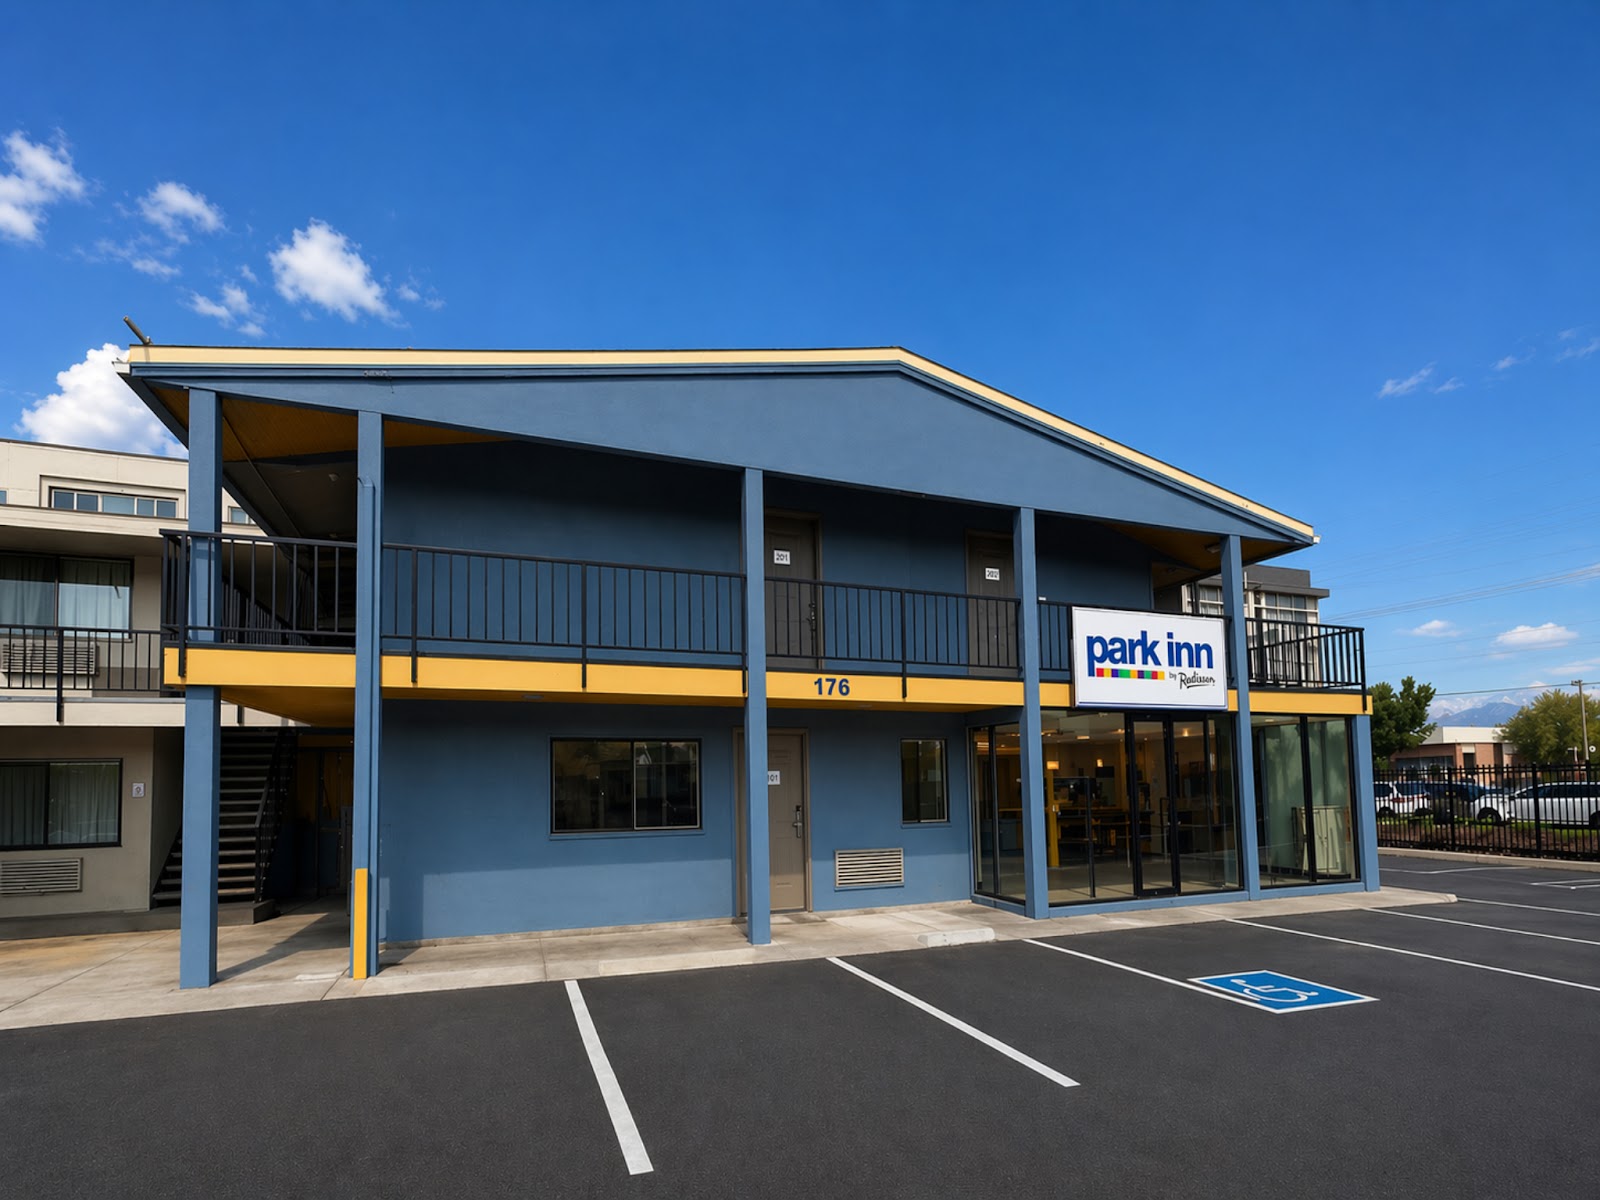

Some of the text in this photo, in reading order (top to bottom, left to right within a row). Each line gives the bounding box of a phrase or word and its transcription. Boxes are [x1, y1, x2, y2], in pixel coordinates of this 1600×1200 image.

[775, 552, 788, 562] 201
[1086, 630, 1213, 677] park inn
[814, 677, 850, 696] 176
[1169, 671, 1216, 690] by Radisson
